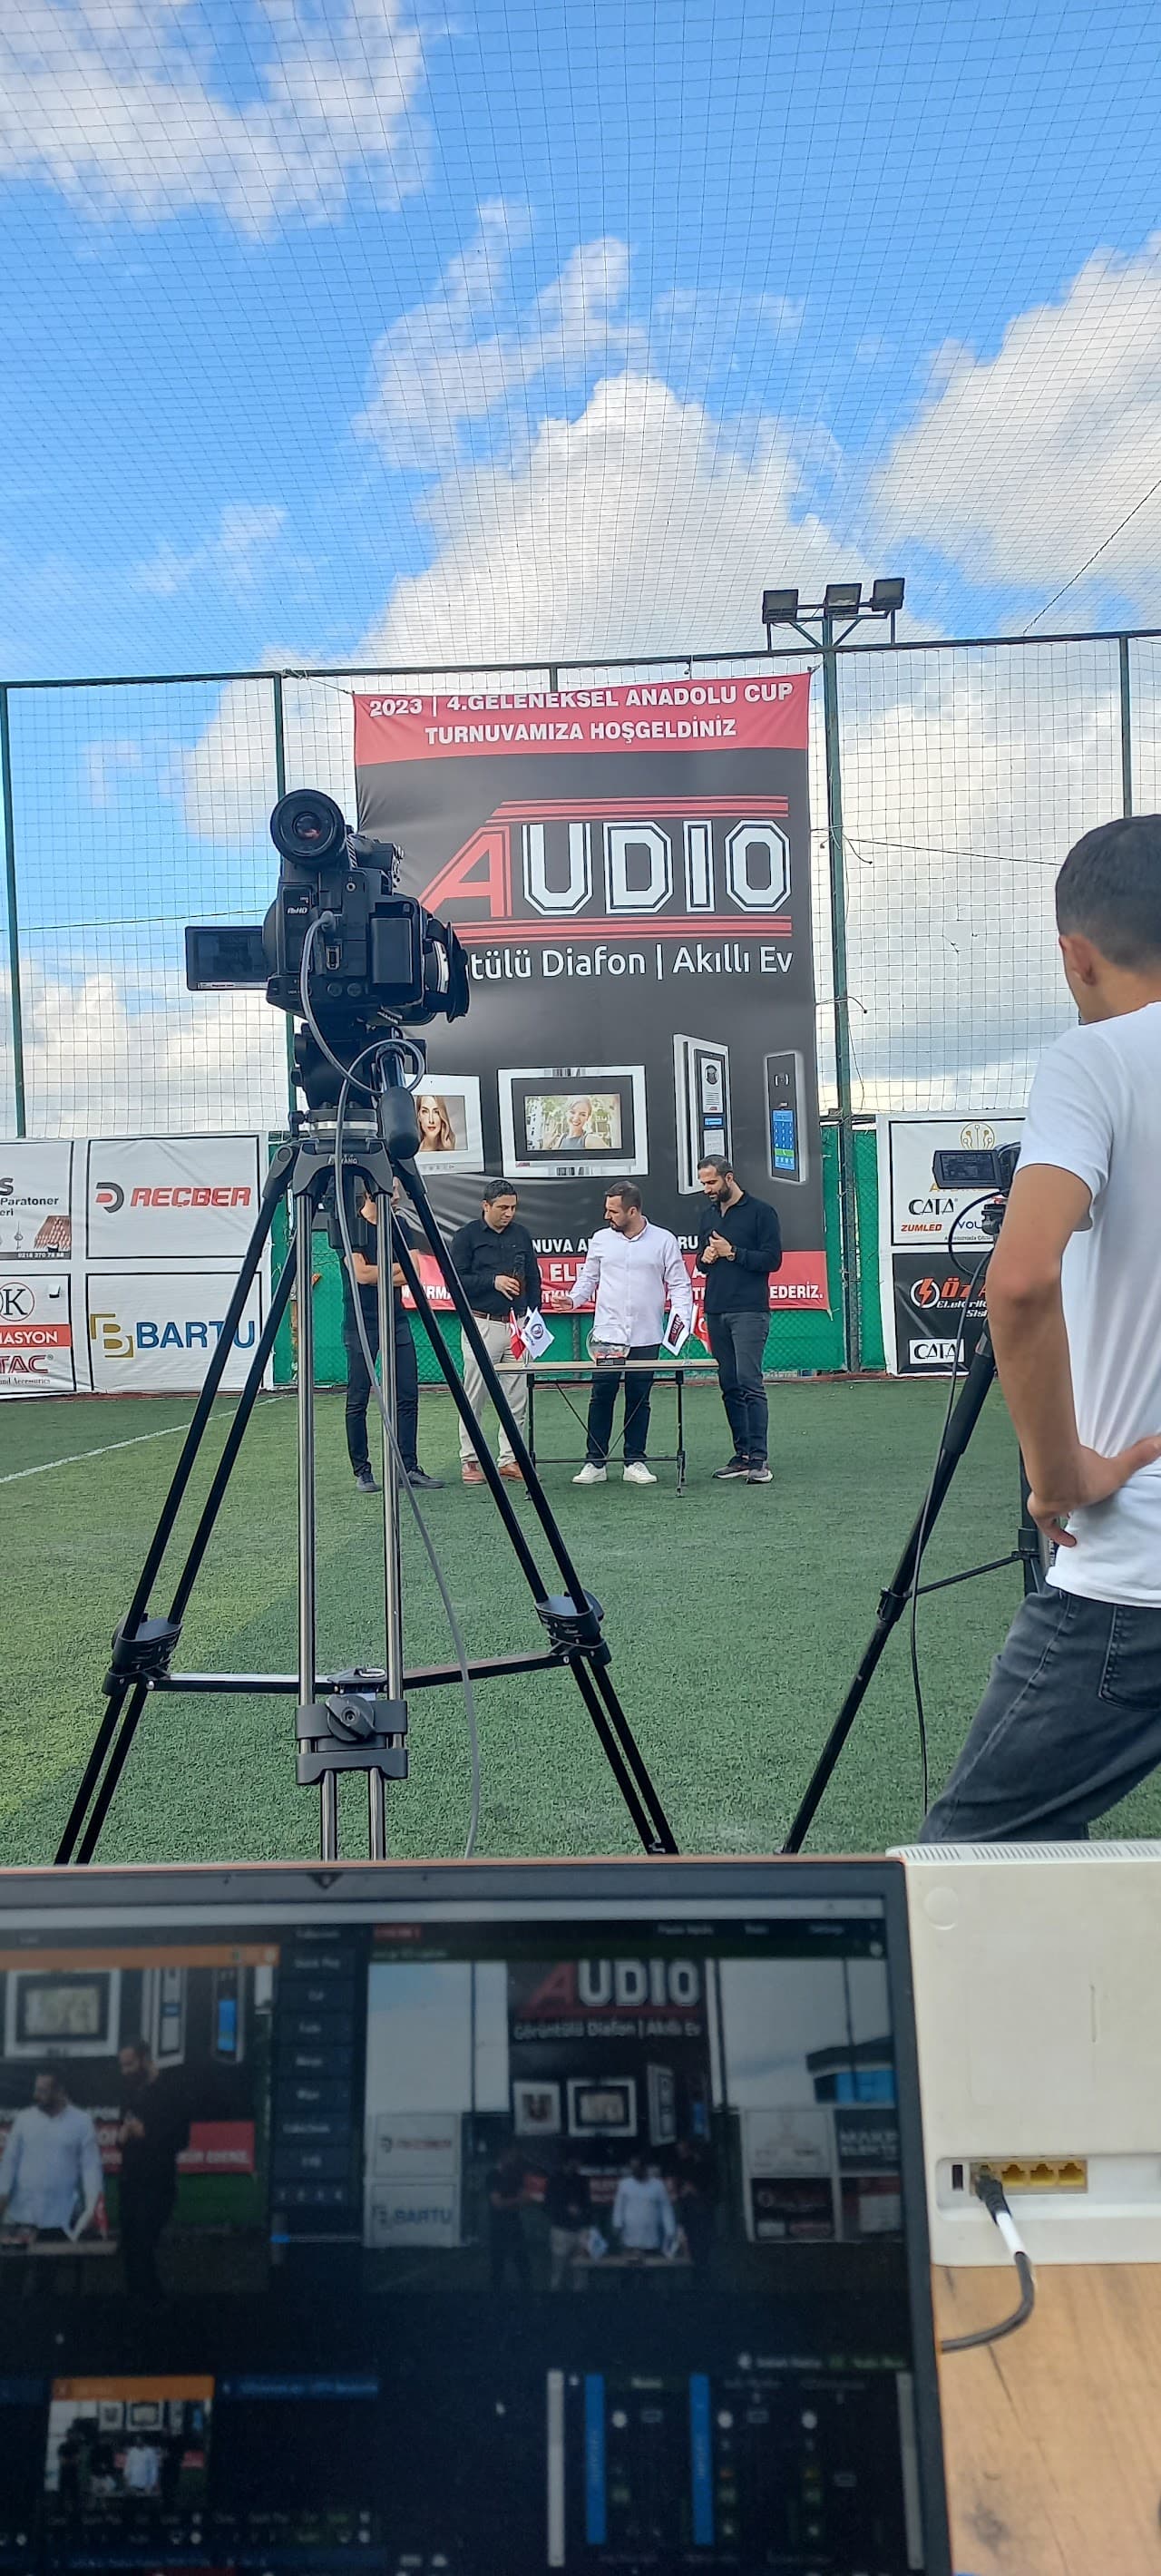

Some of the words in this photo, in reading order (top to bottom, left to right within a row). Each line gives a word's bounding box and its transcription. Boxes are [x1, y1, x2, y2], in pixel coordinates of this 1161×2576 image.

[369, 698, 423, 717] 2023
[446, 690, 619, 711] 4.GELENEKSEL
[625, 686, 738, 707] ANADOLU
[744, 682, 794, 702] CUP
[425, 723, 584, 745] TURNUVAMIZA
[590, 717, 737, 744] HOŞGELDİNİZ
[416, 819, 793, 918] AUDIO
[466, 945, 532, 981] tülü
[541, 945, 646, 977] Diafon
[673, 942, 750, 974] Akıllı
[760, 947, 793, 973] Ev
[0, 1196, 59, 1205] Paratoner
[908, 1198, 954, 1215] CATA
[901, 1224, 942, 1232] ZUMLED
[532, 1238, 573, 1254] NUVA
[0, 1331, 58, 1345] ASYON
